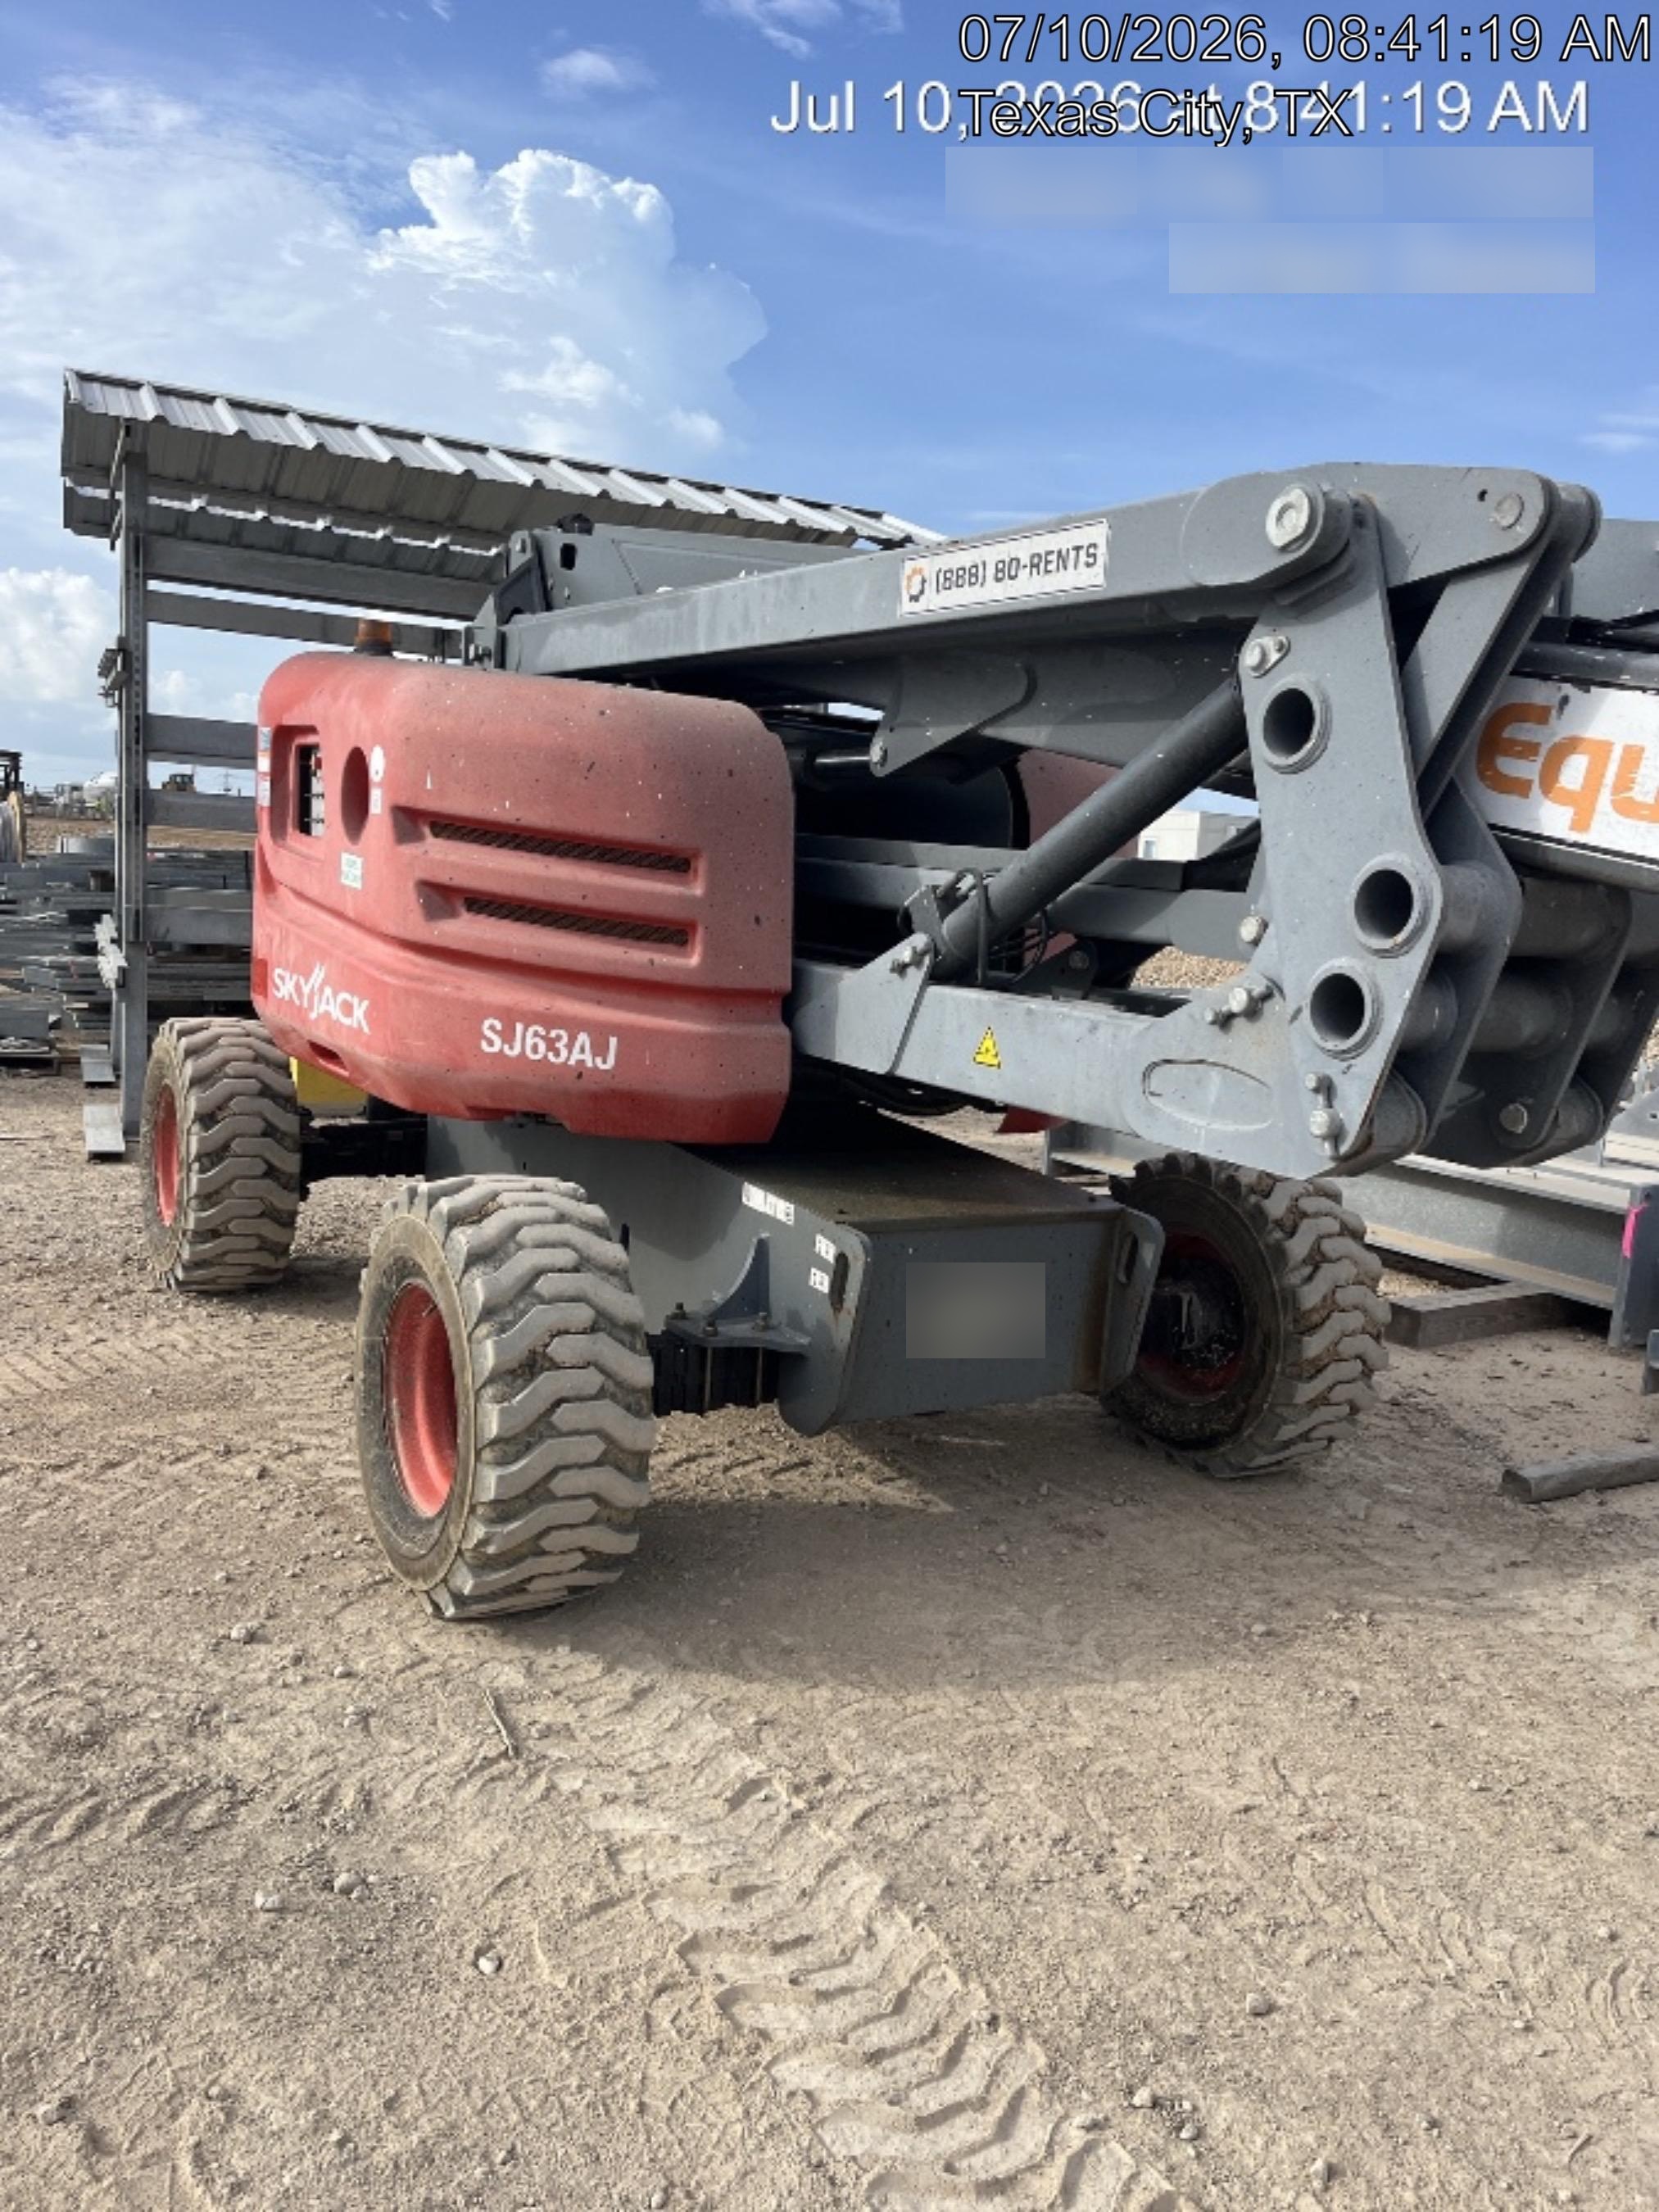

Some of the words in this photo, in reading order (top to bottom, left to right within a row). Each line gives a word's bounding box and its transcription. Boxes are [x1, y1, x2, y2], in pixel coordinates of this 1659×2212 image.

[936, 560, 986, 593] (888)
[994, 542, 1099, 583] 80-RENTS
[271, 960, 370, 1036] SKYJACK
[480, 1017, 618, 1071] SJ63AJ
